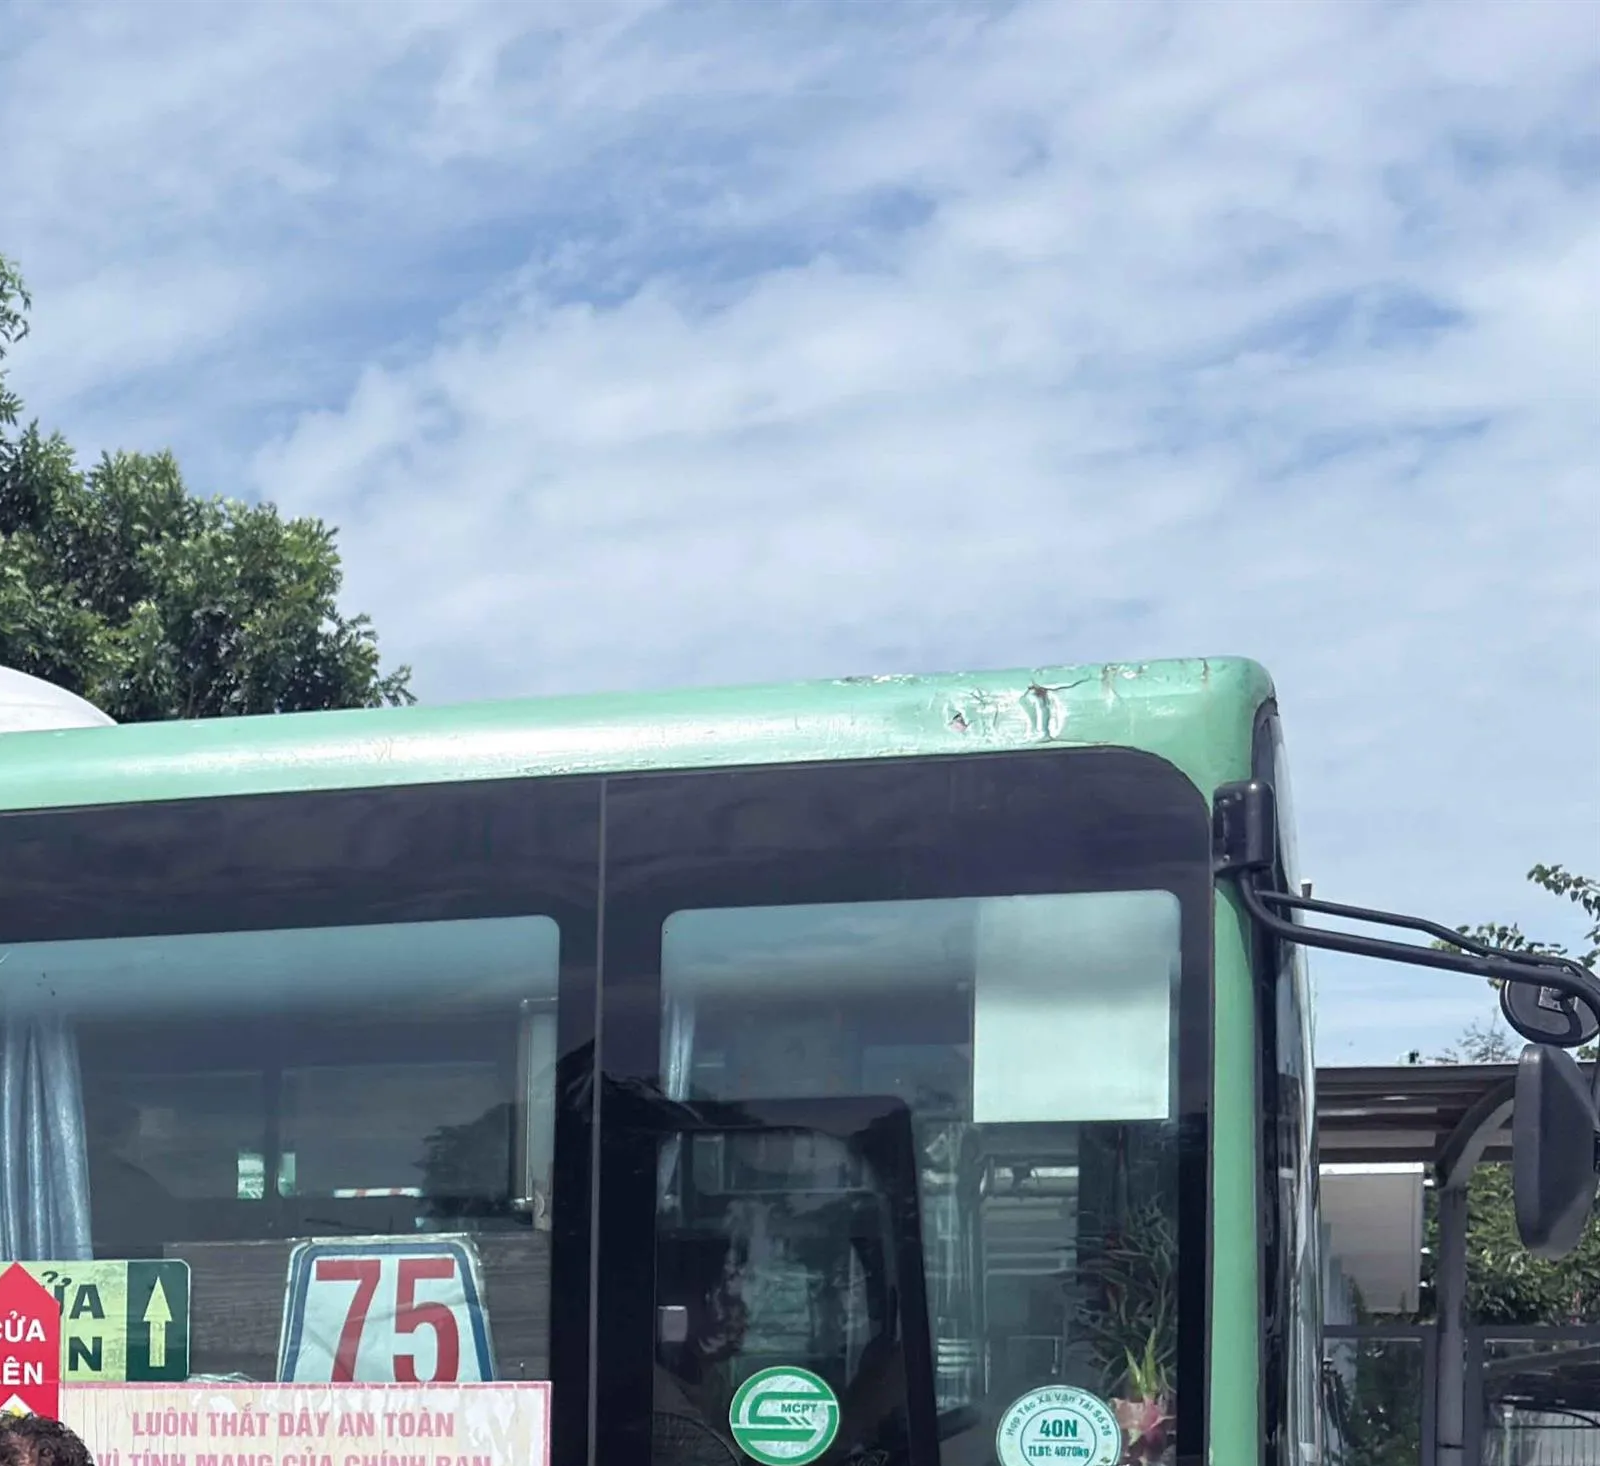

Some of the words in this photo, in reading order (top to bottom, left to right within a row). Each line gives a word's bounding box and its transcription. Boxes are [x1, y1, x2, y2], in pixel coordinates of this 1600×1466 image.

[315, 1258, 460, 1383] 75
[132, 1407, 198, 1437] LUÔN
[207, 1402, 270, 1437] THẮT
[278, 1406, 330, 1437] DÂY
[338, 1412, 375, 1437] AN
[384, 1407, 454, 1438] TOÀN
[1040, 1419, 1078, 1438] 40N
